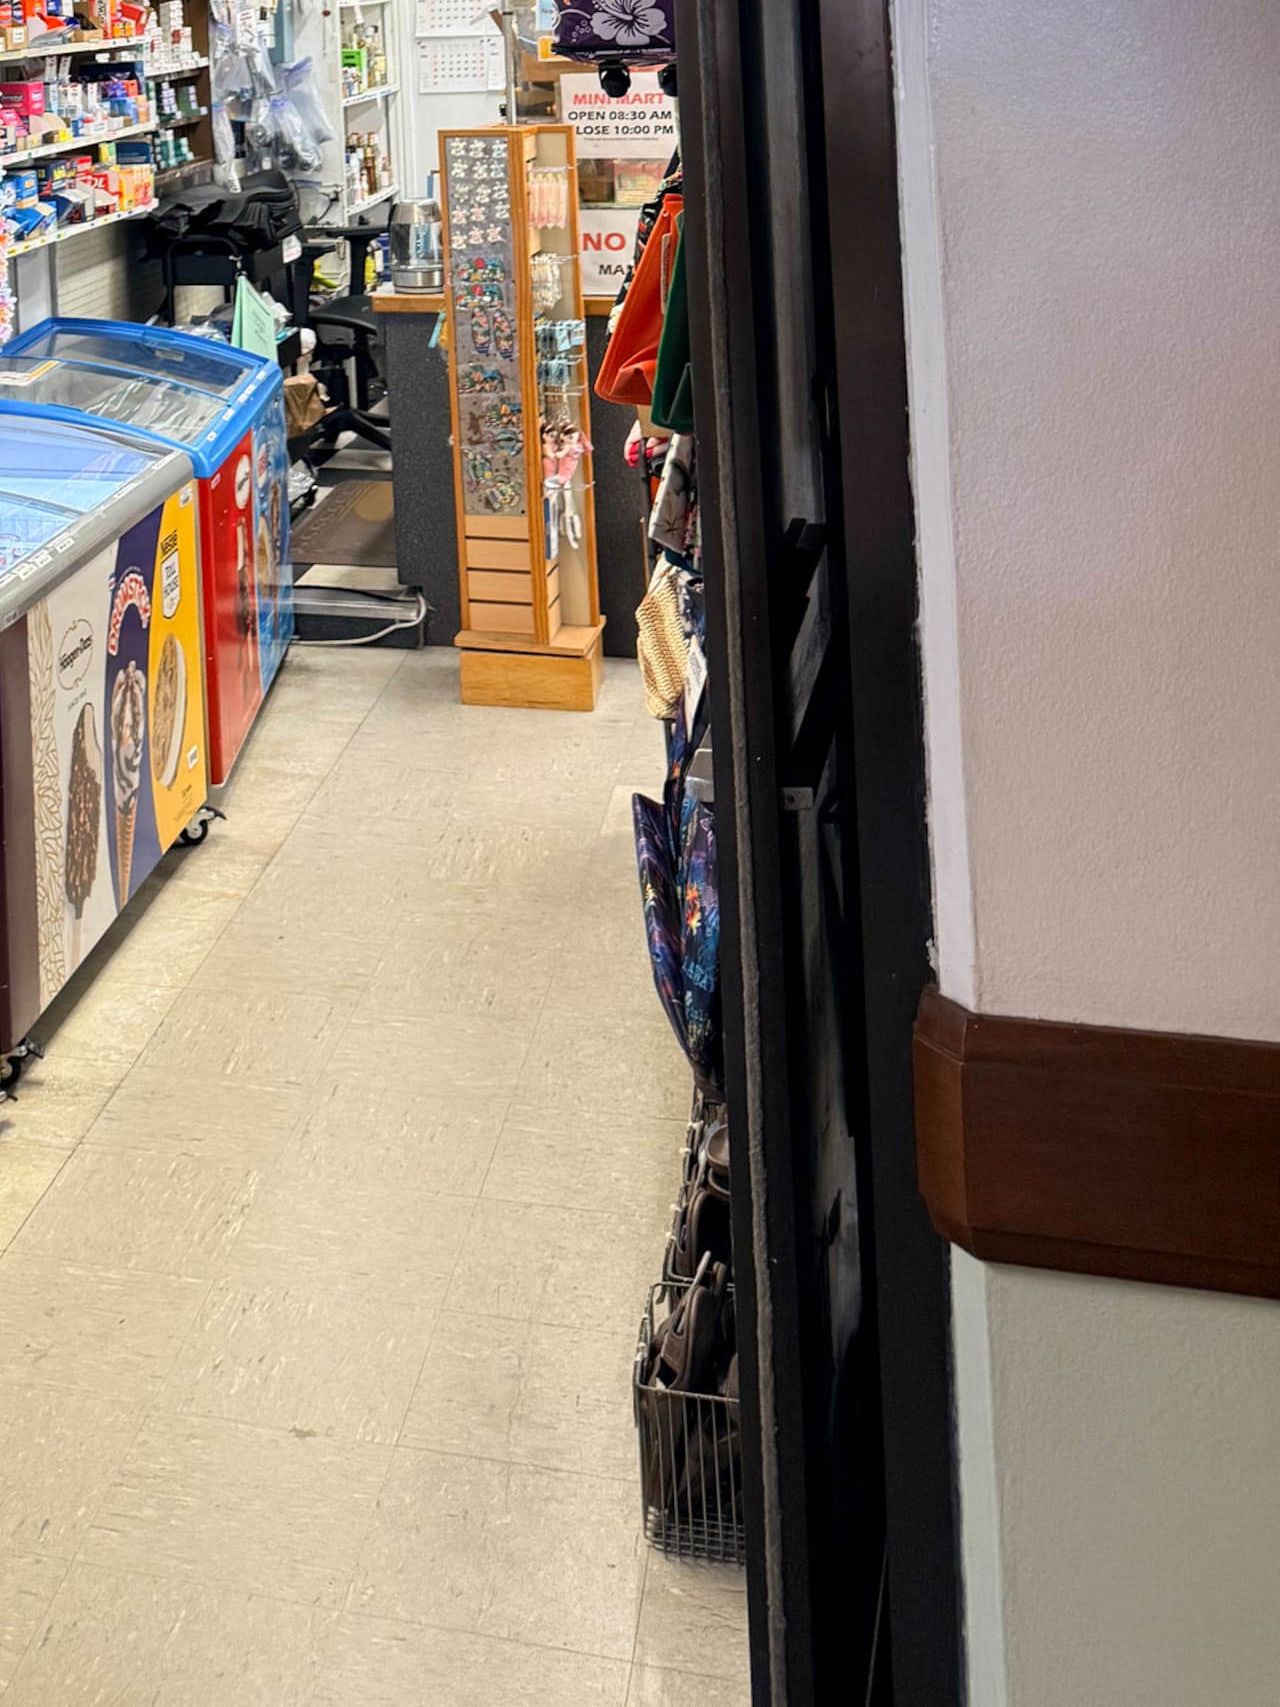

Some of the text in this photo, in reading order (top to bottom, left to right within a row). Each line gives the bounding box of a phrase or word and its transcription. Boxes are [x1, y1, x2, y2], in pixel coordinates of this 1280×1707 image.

[568, 110, 672, 120] OPEN 08:30 AM
[576, 125, 674, 135] LOSE 10:00 PM
[582, 232, 626, 252] NO
